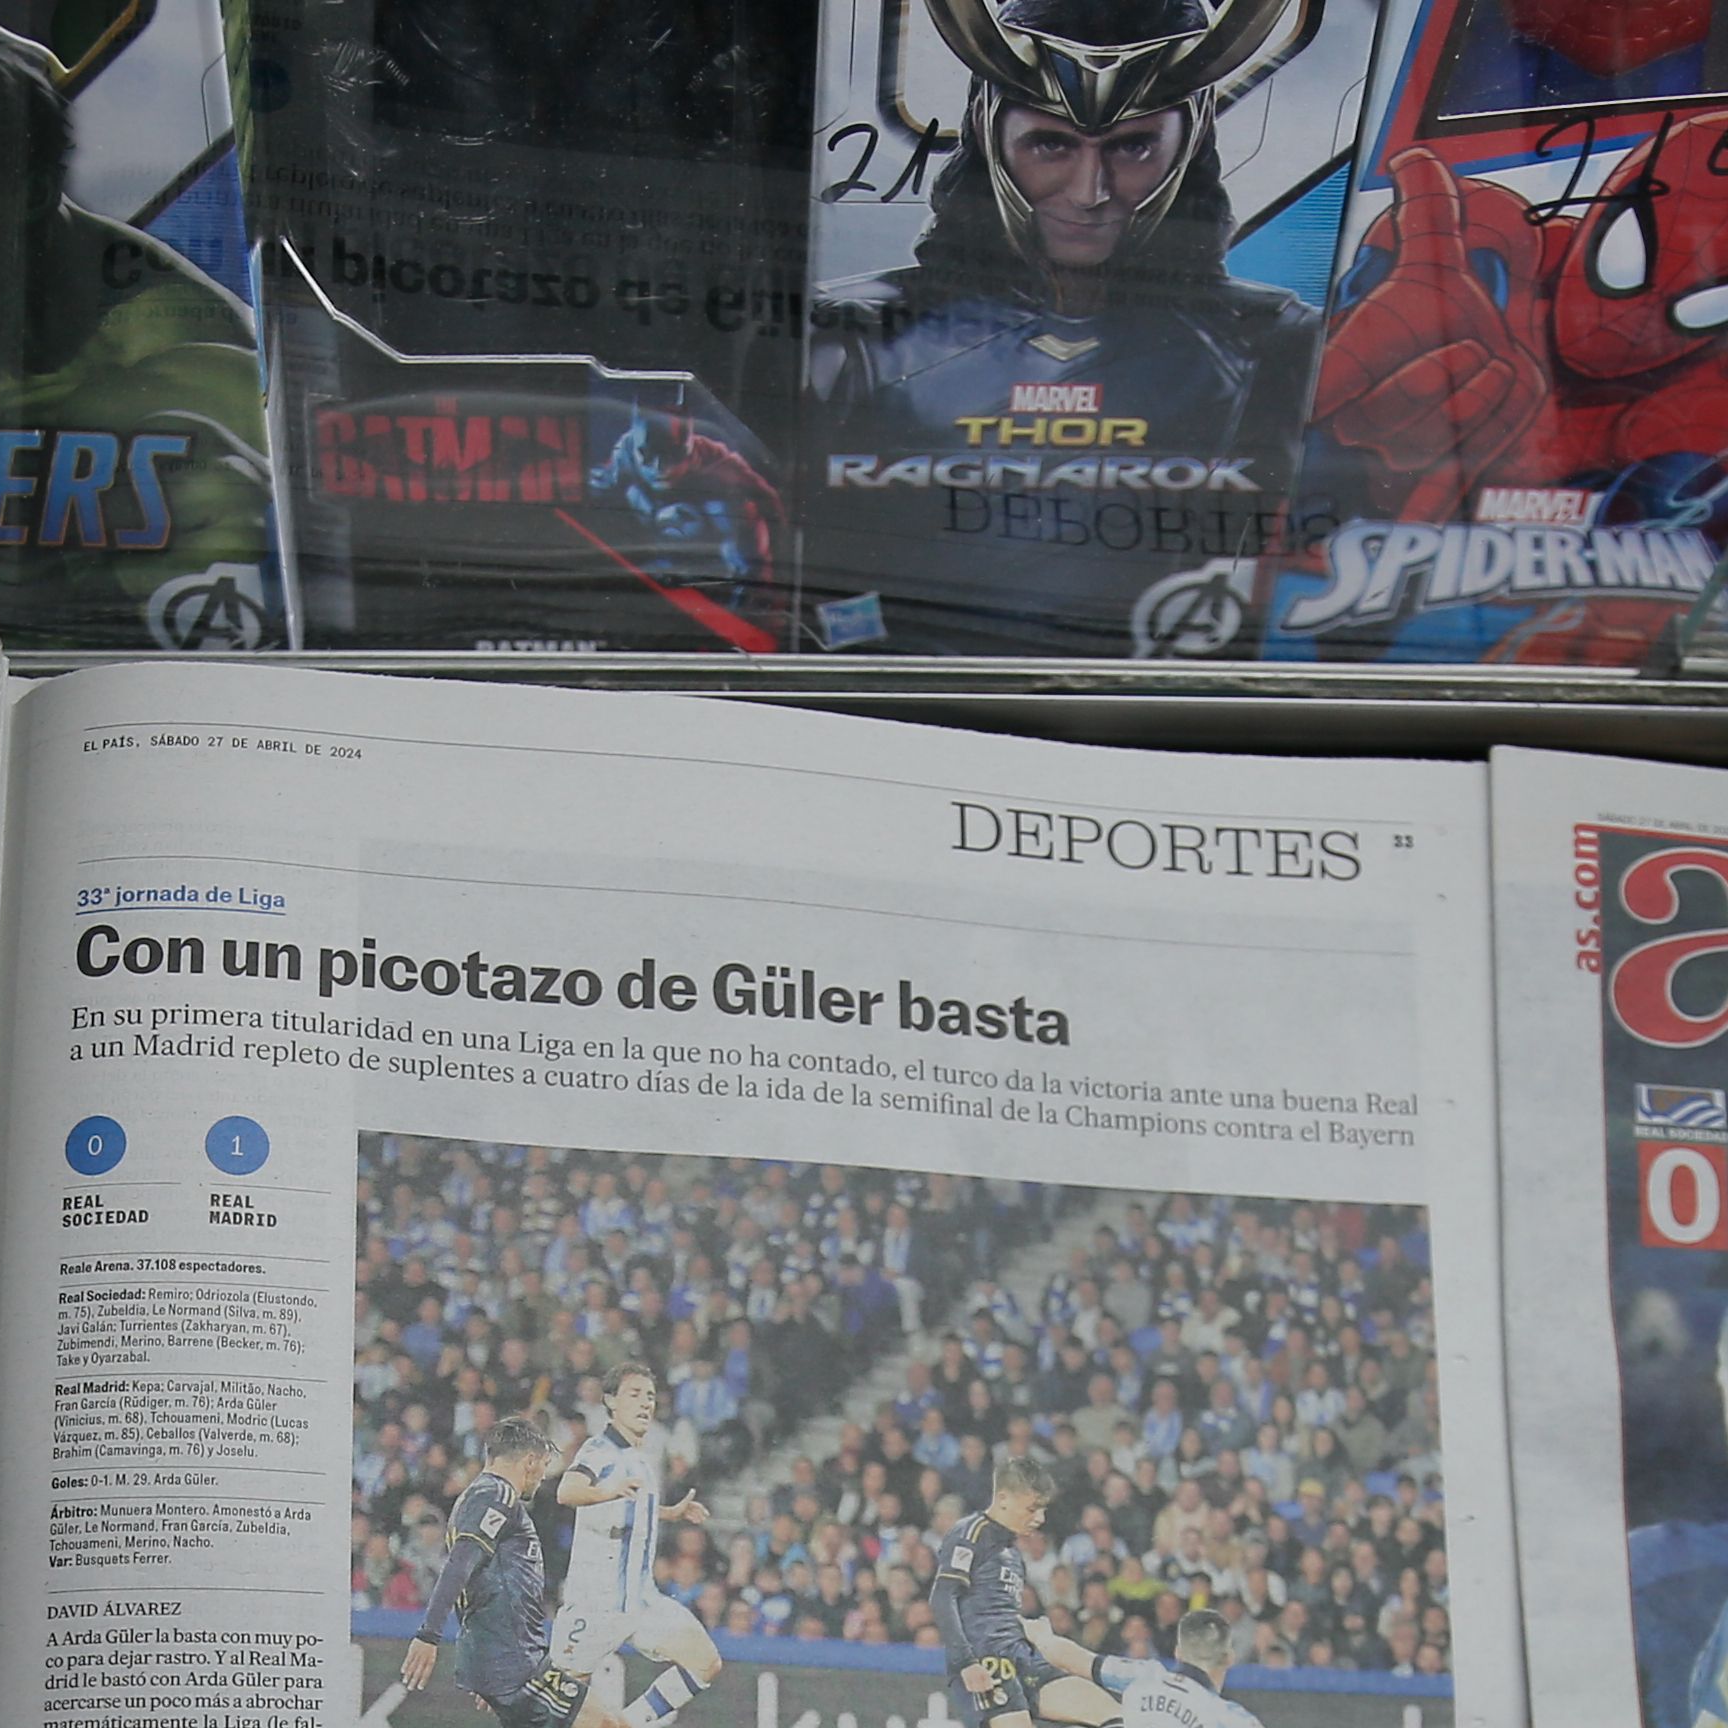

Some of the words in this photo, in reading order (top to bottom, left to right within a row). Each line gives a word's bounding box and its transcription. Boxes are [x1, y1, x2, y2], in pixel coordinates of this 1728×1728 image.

[1011, 384, 1101, 412] MARVEL
[957, 417, 1147, 448] THOR
[827, 454, 1257, 490] RAGNAROK
[1476, 489, 1593, 527] MARVEL
[1287, 518, 1721, 632] SPIDER-MAN
[83, 740, 99, 753] EL
[102, 735, 141, 751] PAÍS,
[149, 733, 200, 748] SÁBADO
[207, 735, 224, 748] 27
[231, 736, 248, 749] DE
[256, 737, 298, 753] ABRIL
[305, 742, 322, 757] DE
[329, 746, 363, 759] 2024
[951, 800, 1362, 881] DEPORTES
[76, 886, 112, 909] 33ª
[113, 886, 200, 907] jornada
[206, 886, 232, 905] de
[238, 887, 285, 910] Liga
[1574, 822, 1602, 974] as.com
[75, 924, 206, 977] Con
[221, 935, 302, 981] un
[317, 937, 602, 1007] picotazo
[617, 957, 698, 1014] de
[712, 961, 883, 1025] Güler
[898, 980, 1072, 1048] basta
[62, 1194, 104, 1210] REAL
[210, 1194, 255, 1209] REAL
[1646, 1148, 1721, 1244] 0
[61, 1210, 149, 1227] SOCIEDAD
[210, 1211, 277, 1228] MADRID
[47, 1603, 99, 1620] DAVID
[103, 1601, 182, 1618] ÁLVAREZ
